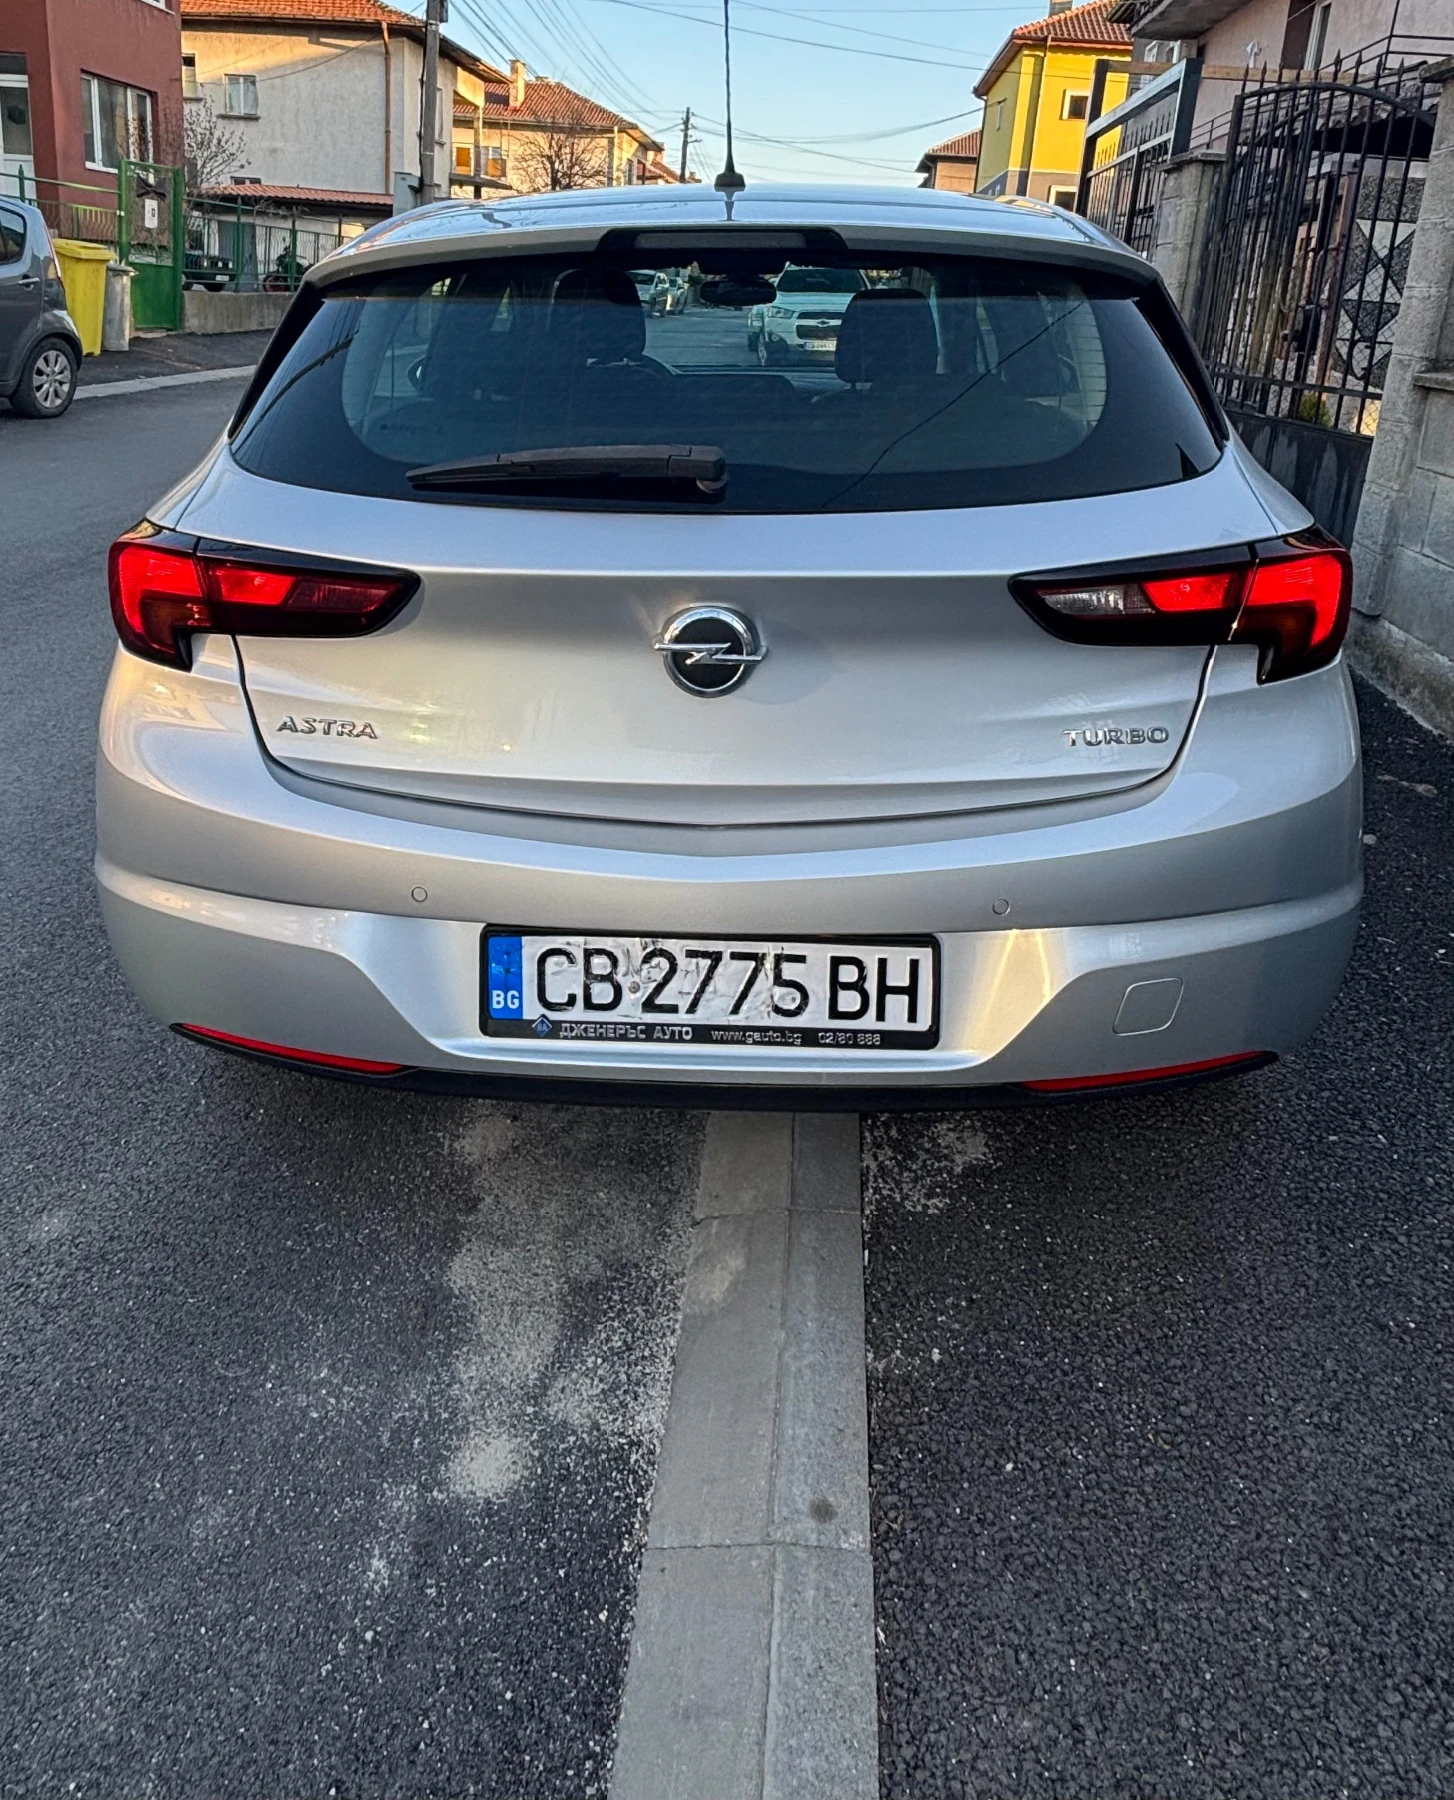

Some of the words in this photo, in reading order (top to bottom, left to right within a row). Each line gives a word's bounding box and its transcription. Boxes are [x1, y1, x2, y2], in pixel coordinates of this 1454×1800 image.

[276, 715, 379, 740] ASTRA
[1062, 725, 1170, 747] TURBO
[536, 946, 623, 1012] CB
[640, 946, 810, 1018] 2775
[828, 955, 920, 1024] BH
[491, 989, 520, 1010] BG
[653, 1025, 693, 1041] АУТО
[711, 1029, 802, 1045] www.gauto.bg
